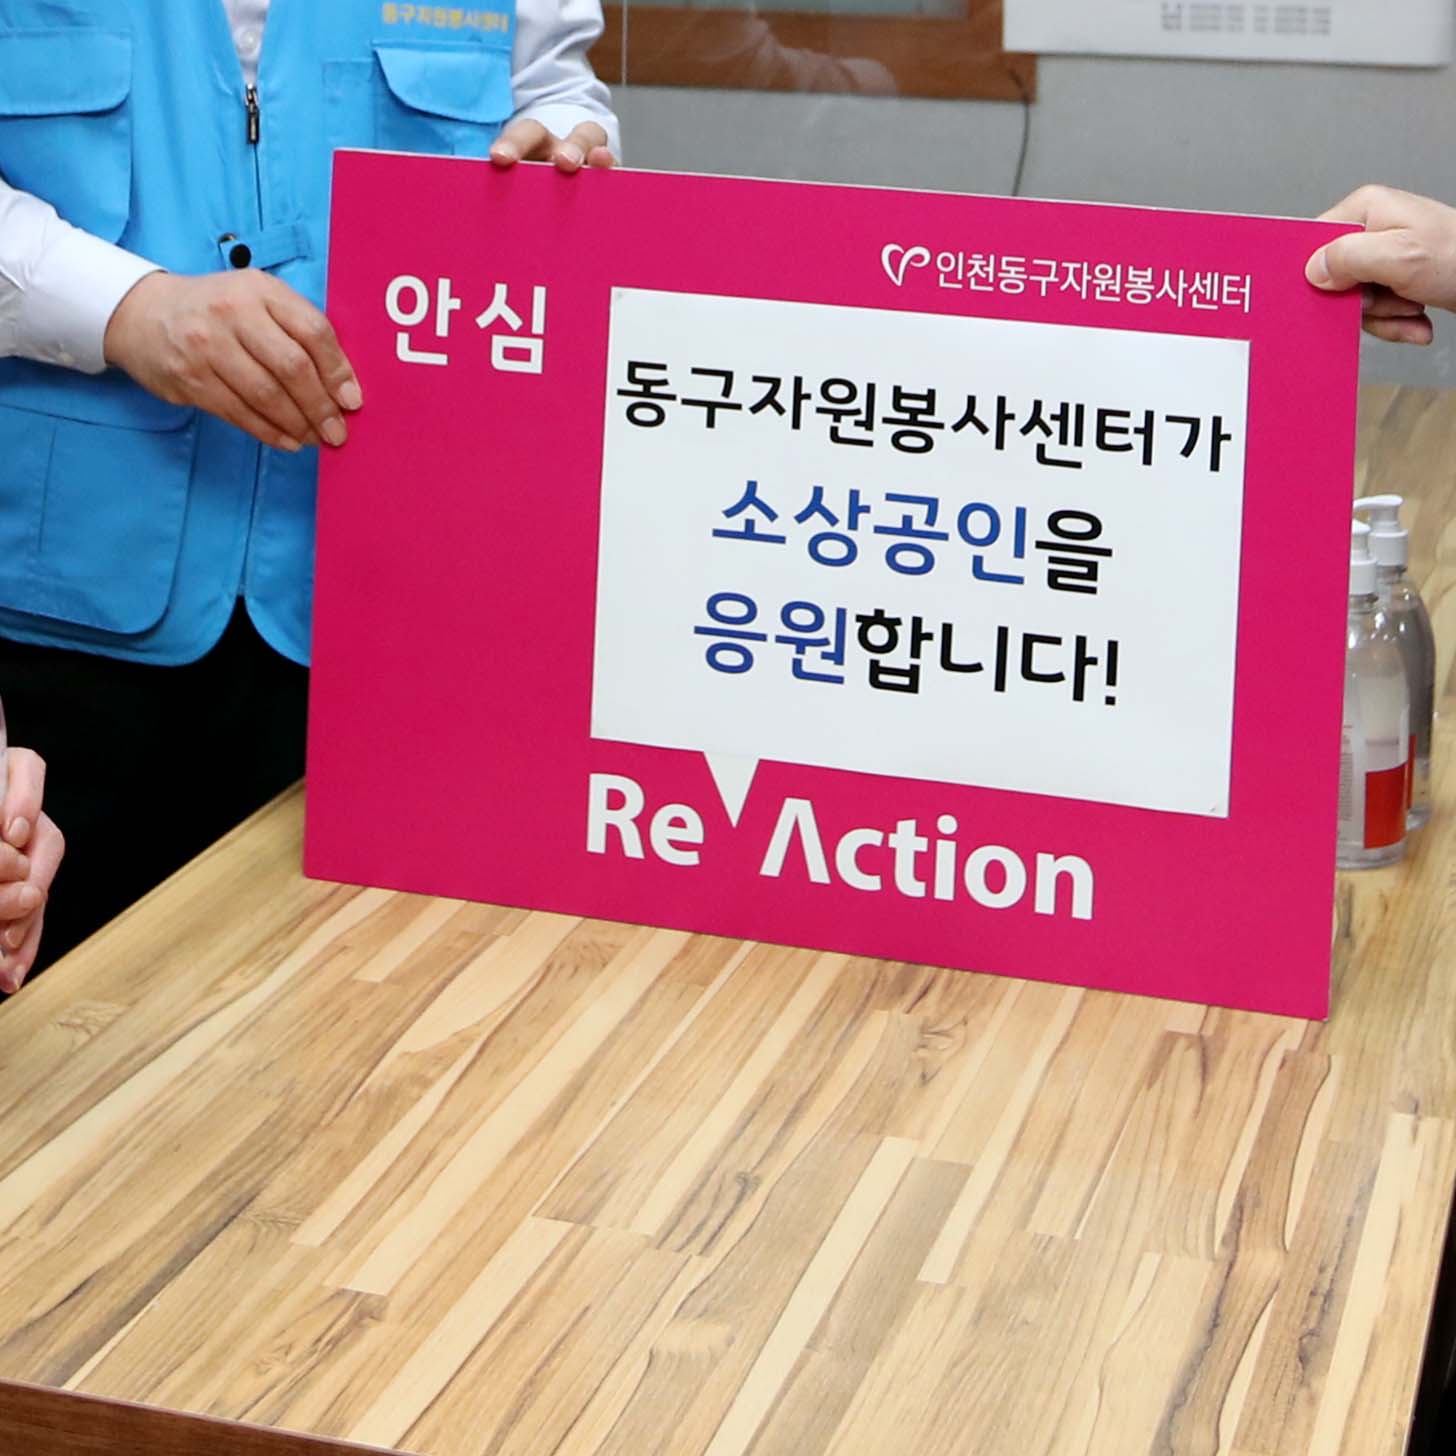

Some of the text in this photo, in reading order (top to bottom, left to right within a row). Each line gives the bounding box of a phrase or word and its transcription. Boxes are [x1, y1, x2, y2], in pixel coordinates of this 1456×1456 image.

[384, 272, 548, 376] 안심
[936, 249, 1251, 314] 인천동구자원봉사센터
[616, 359, 1231, 474] 동구자원봉사센터가
[711, 479, 1113, 594] 소상공인을
[692, 591, 1120, 707] 응원합니다!
[587, 771, 1095, 921] Re Action
